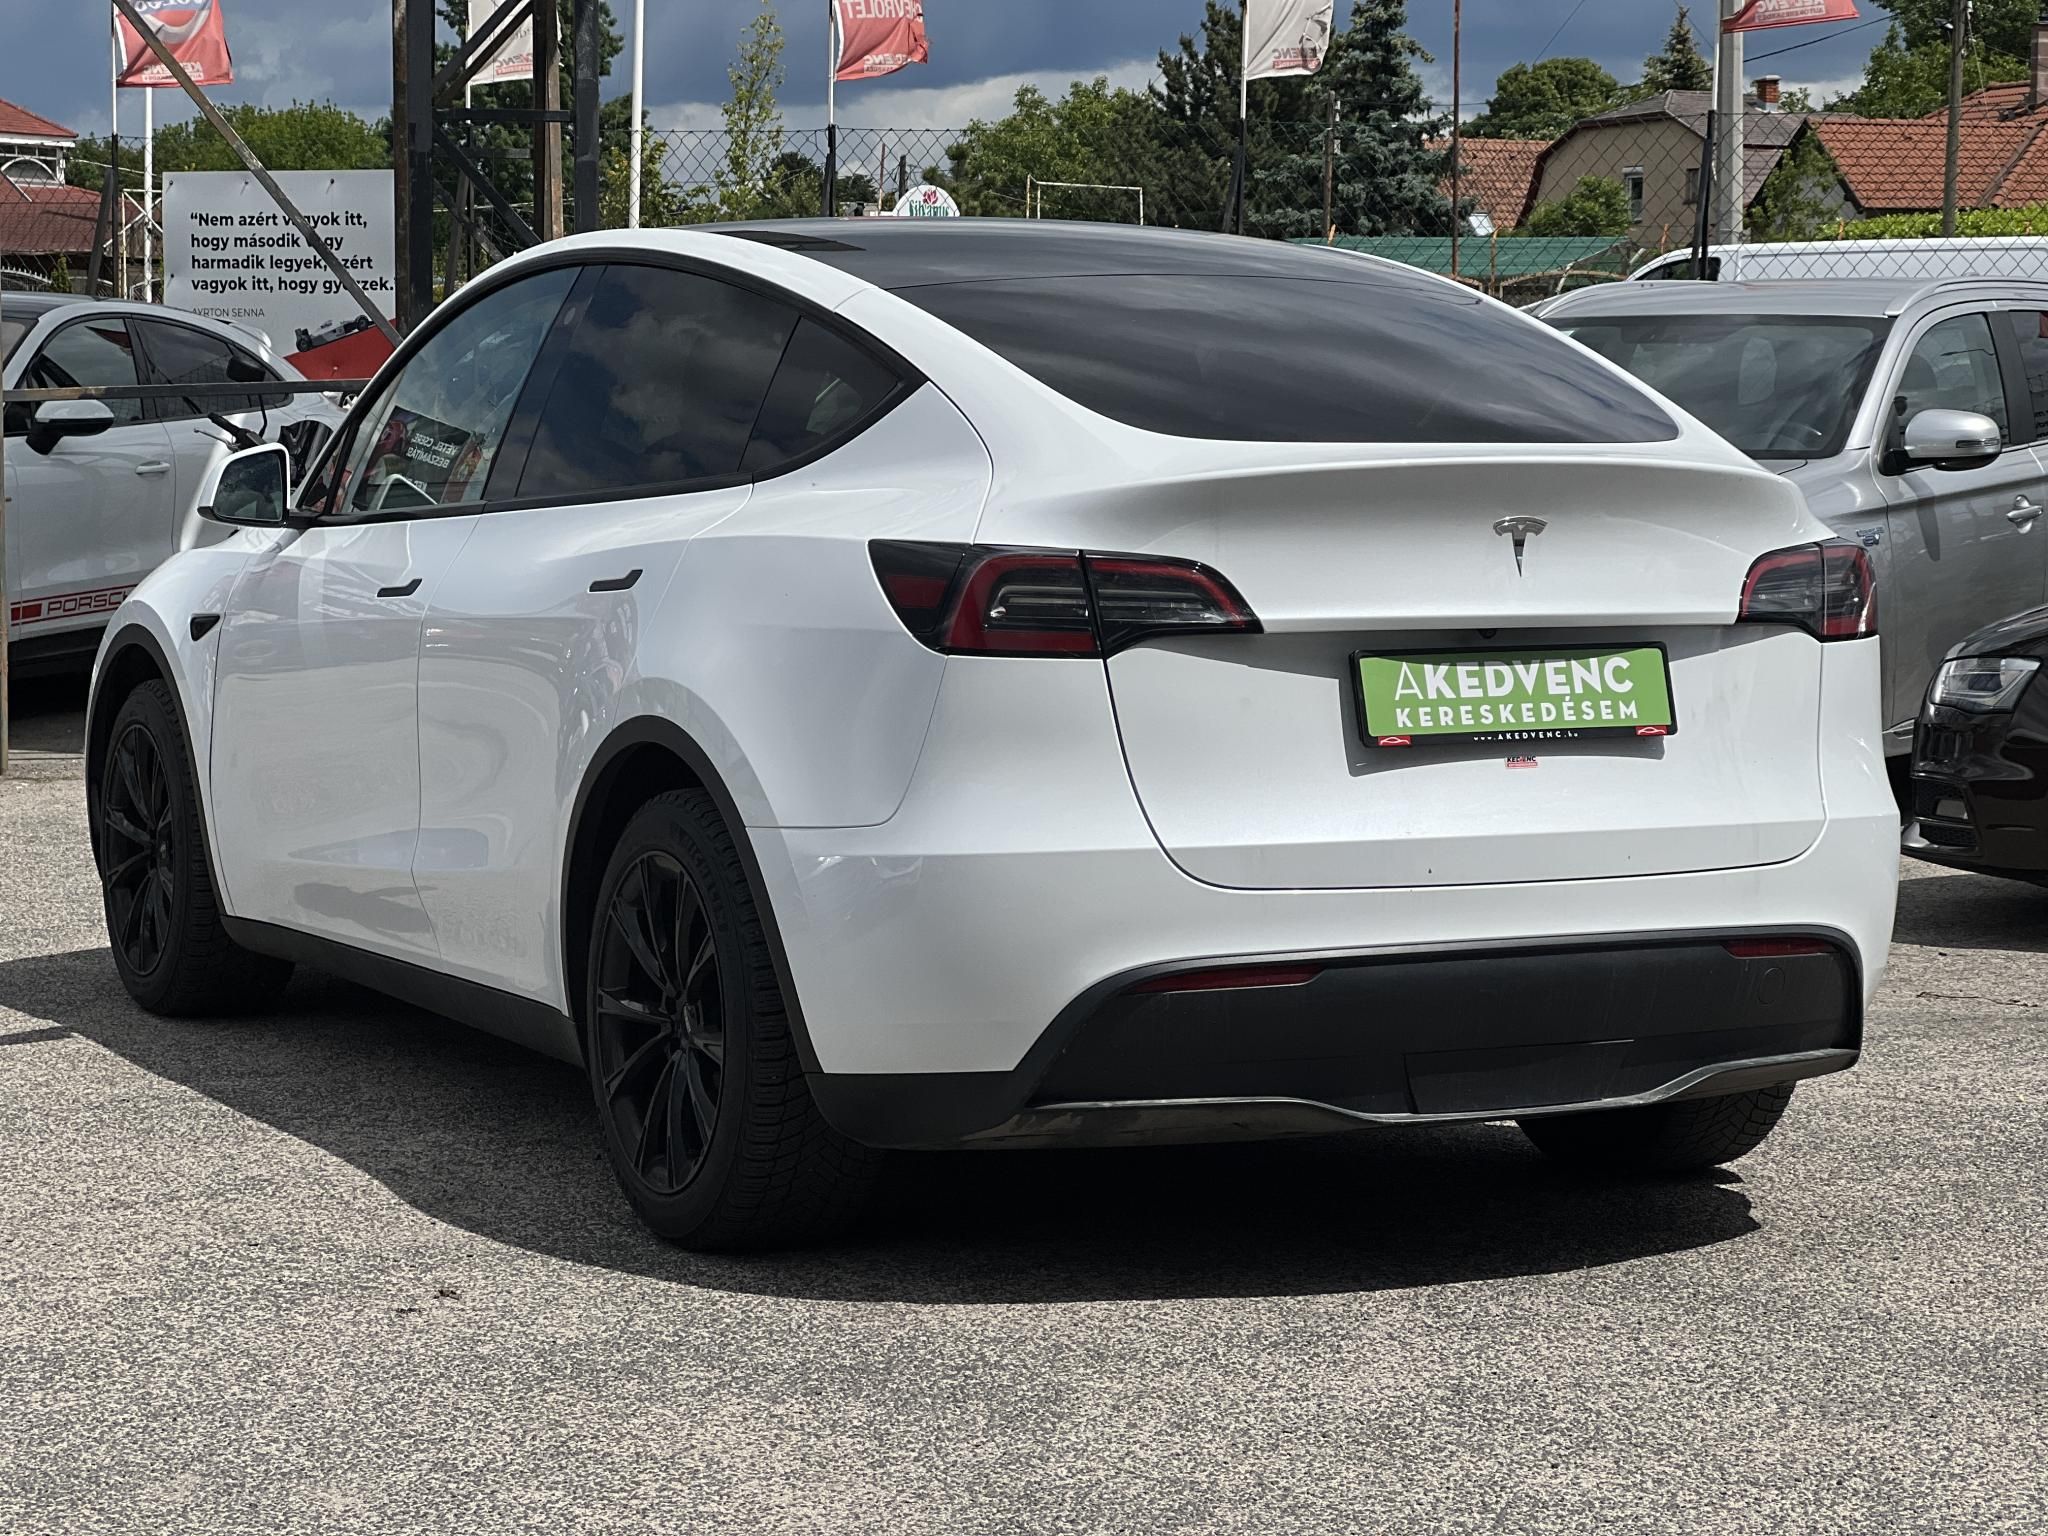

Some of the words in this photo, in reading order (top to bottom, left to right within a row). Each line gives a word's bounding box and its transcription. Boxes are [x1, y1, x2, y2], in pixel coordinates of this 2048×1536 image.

[239, 212, 278, 226] azért
[283, 211, 340, 228] vyok
[345, 211, 367, 228] itt,
[191, 233, 229, 251] hogy
[234, 233, 301, 248] második
[304, 236, 343, 250] gy
[191, 254, 265, 269] harmadik
[270, 255, 327, 272] legyek,
[338, 254, 374, 269] zért
[191, 276, 247, 294] vagyok
[252, 275, 274, 293] itt,
[278, 276, 318, 294] hogy
[192, 307, 229, 317] AYRTON
[231, 307, 265, 318] SENNA
[1395, 695, 1639, 729] KERESKEDÉSEM
